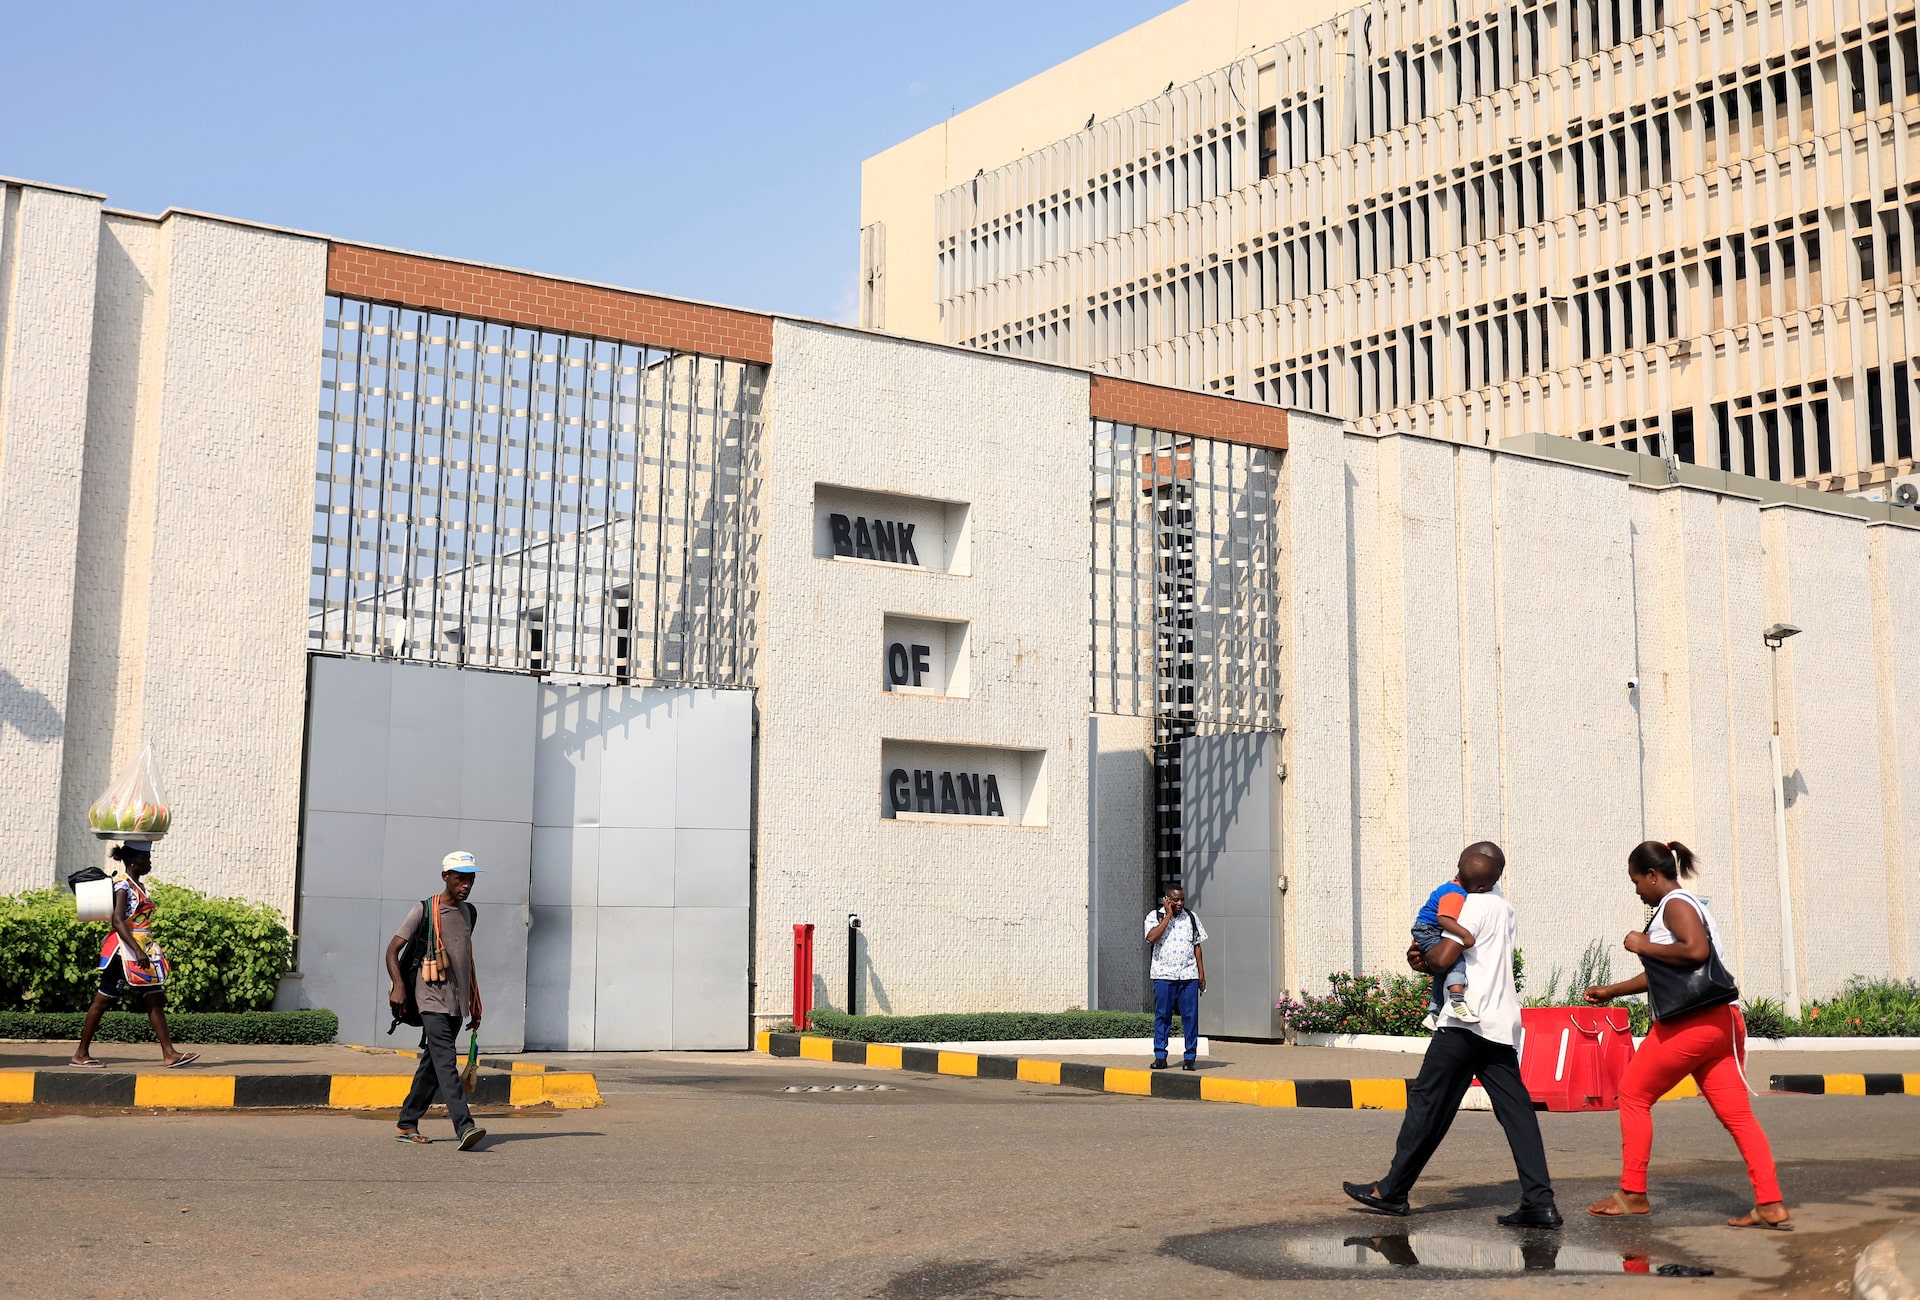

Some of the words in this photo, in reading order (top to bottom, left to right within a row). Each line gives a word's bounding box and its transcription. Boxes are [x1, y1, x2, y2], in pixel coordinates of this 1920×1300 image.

[830, 513, 919, 565] BANK
[889, 642, 930, 687] OF
[889, 768, 1004, 816] GHANA
